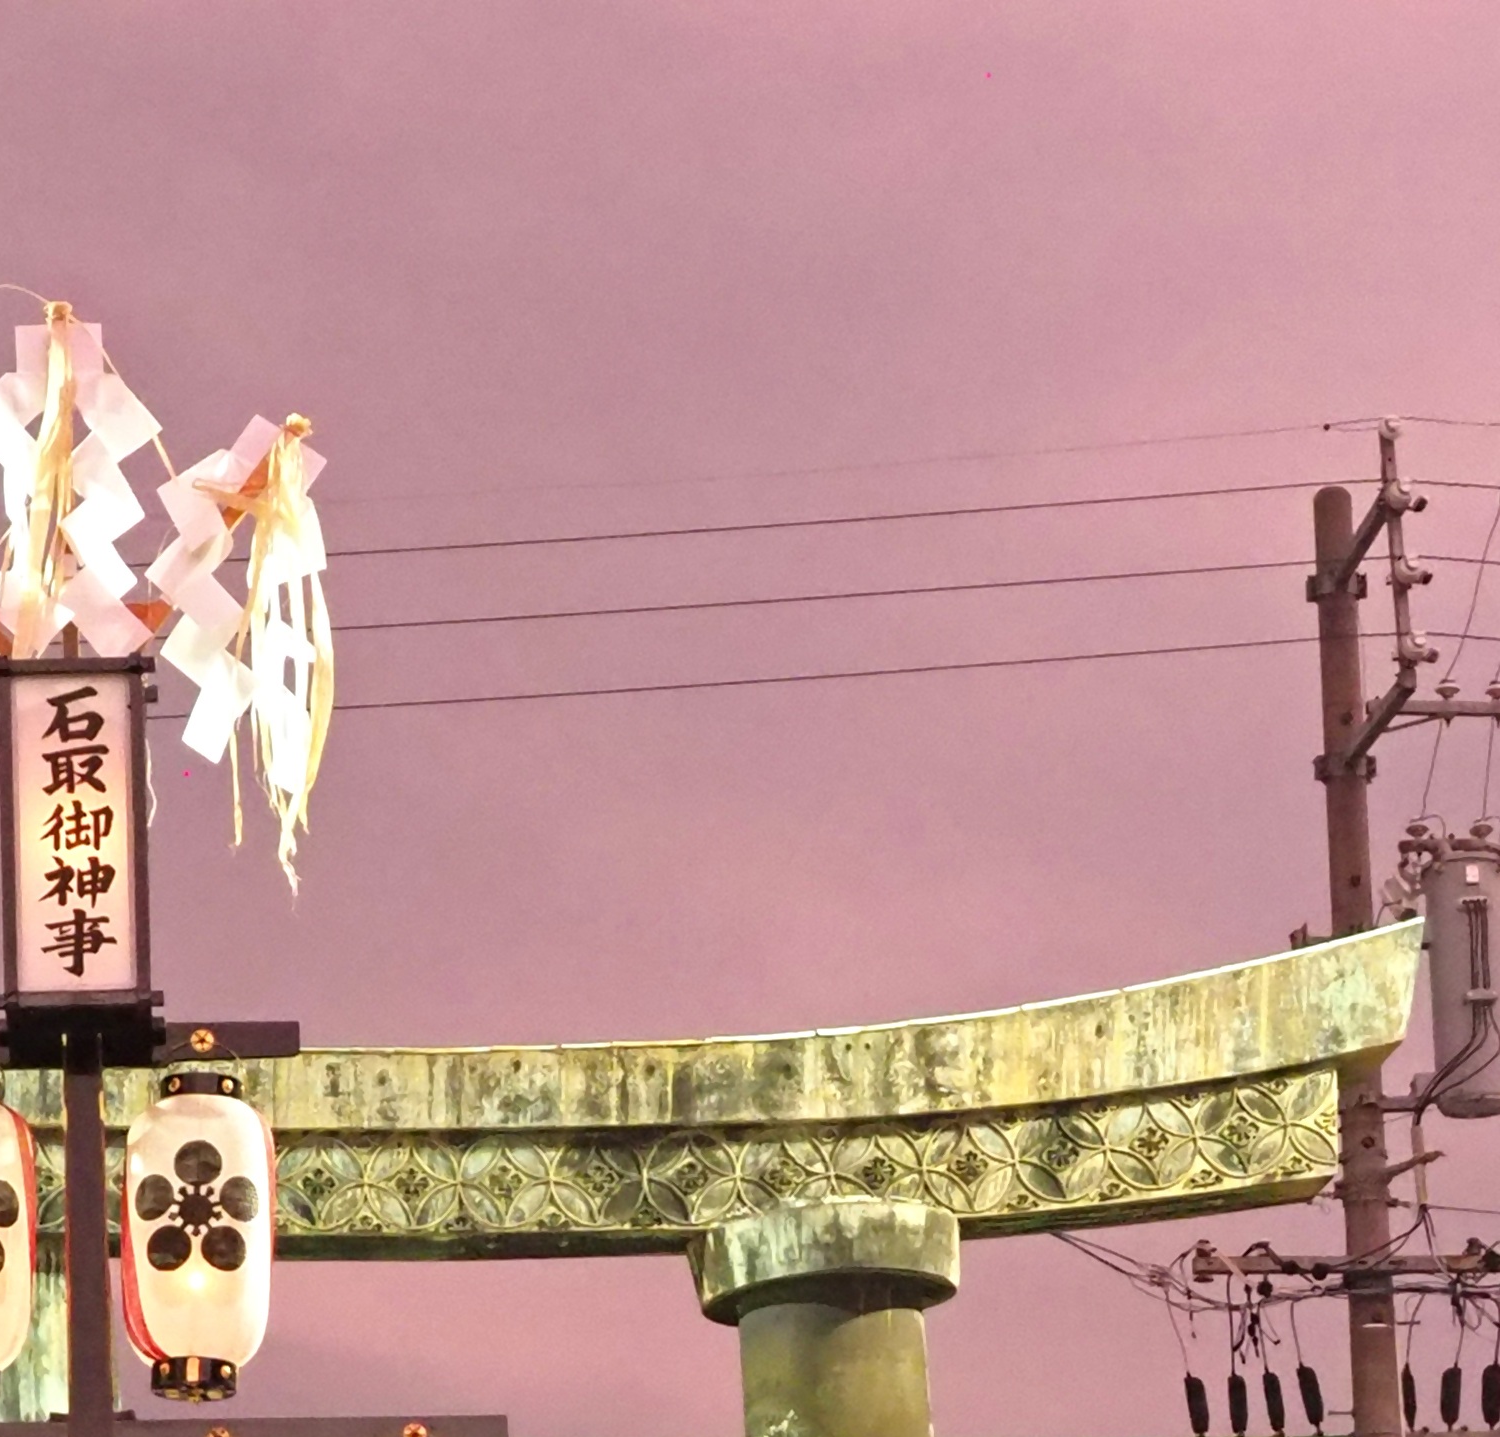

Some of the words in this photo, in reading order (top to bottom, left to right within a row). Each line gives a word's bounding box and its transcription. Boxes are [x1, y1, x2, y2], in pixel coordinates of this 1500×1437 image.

[38, 686, 117, 977] 石取御神事
